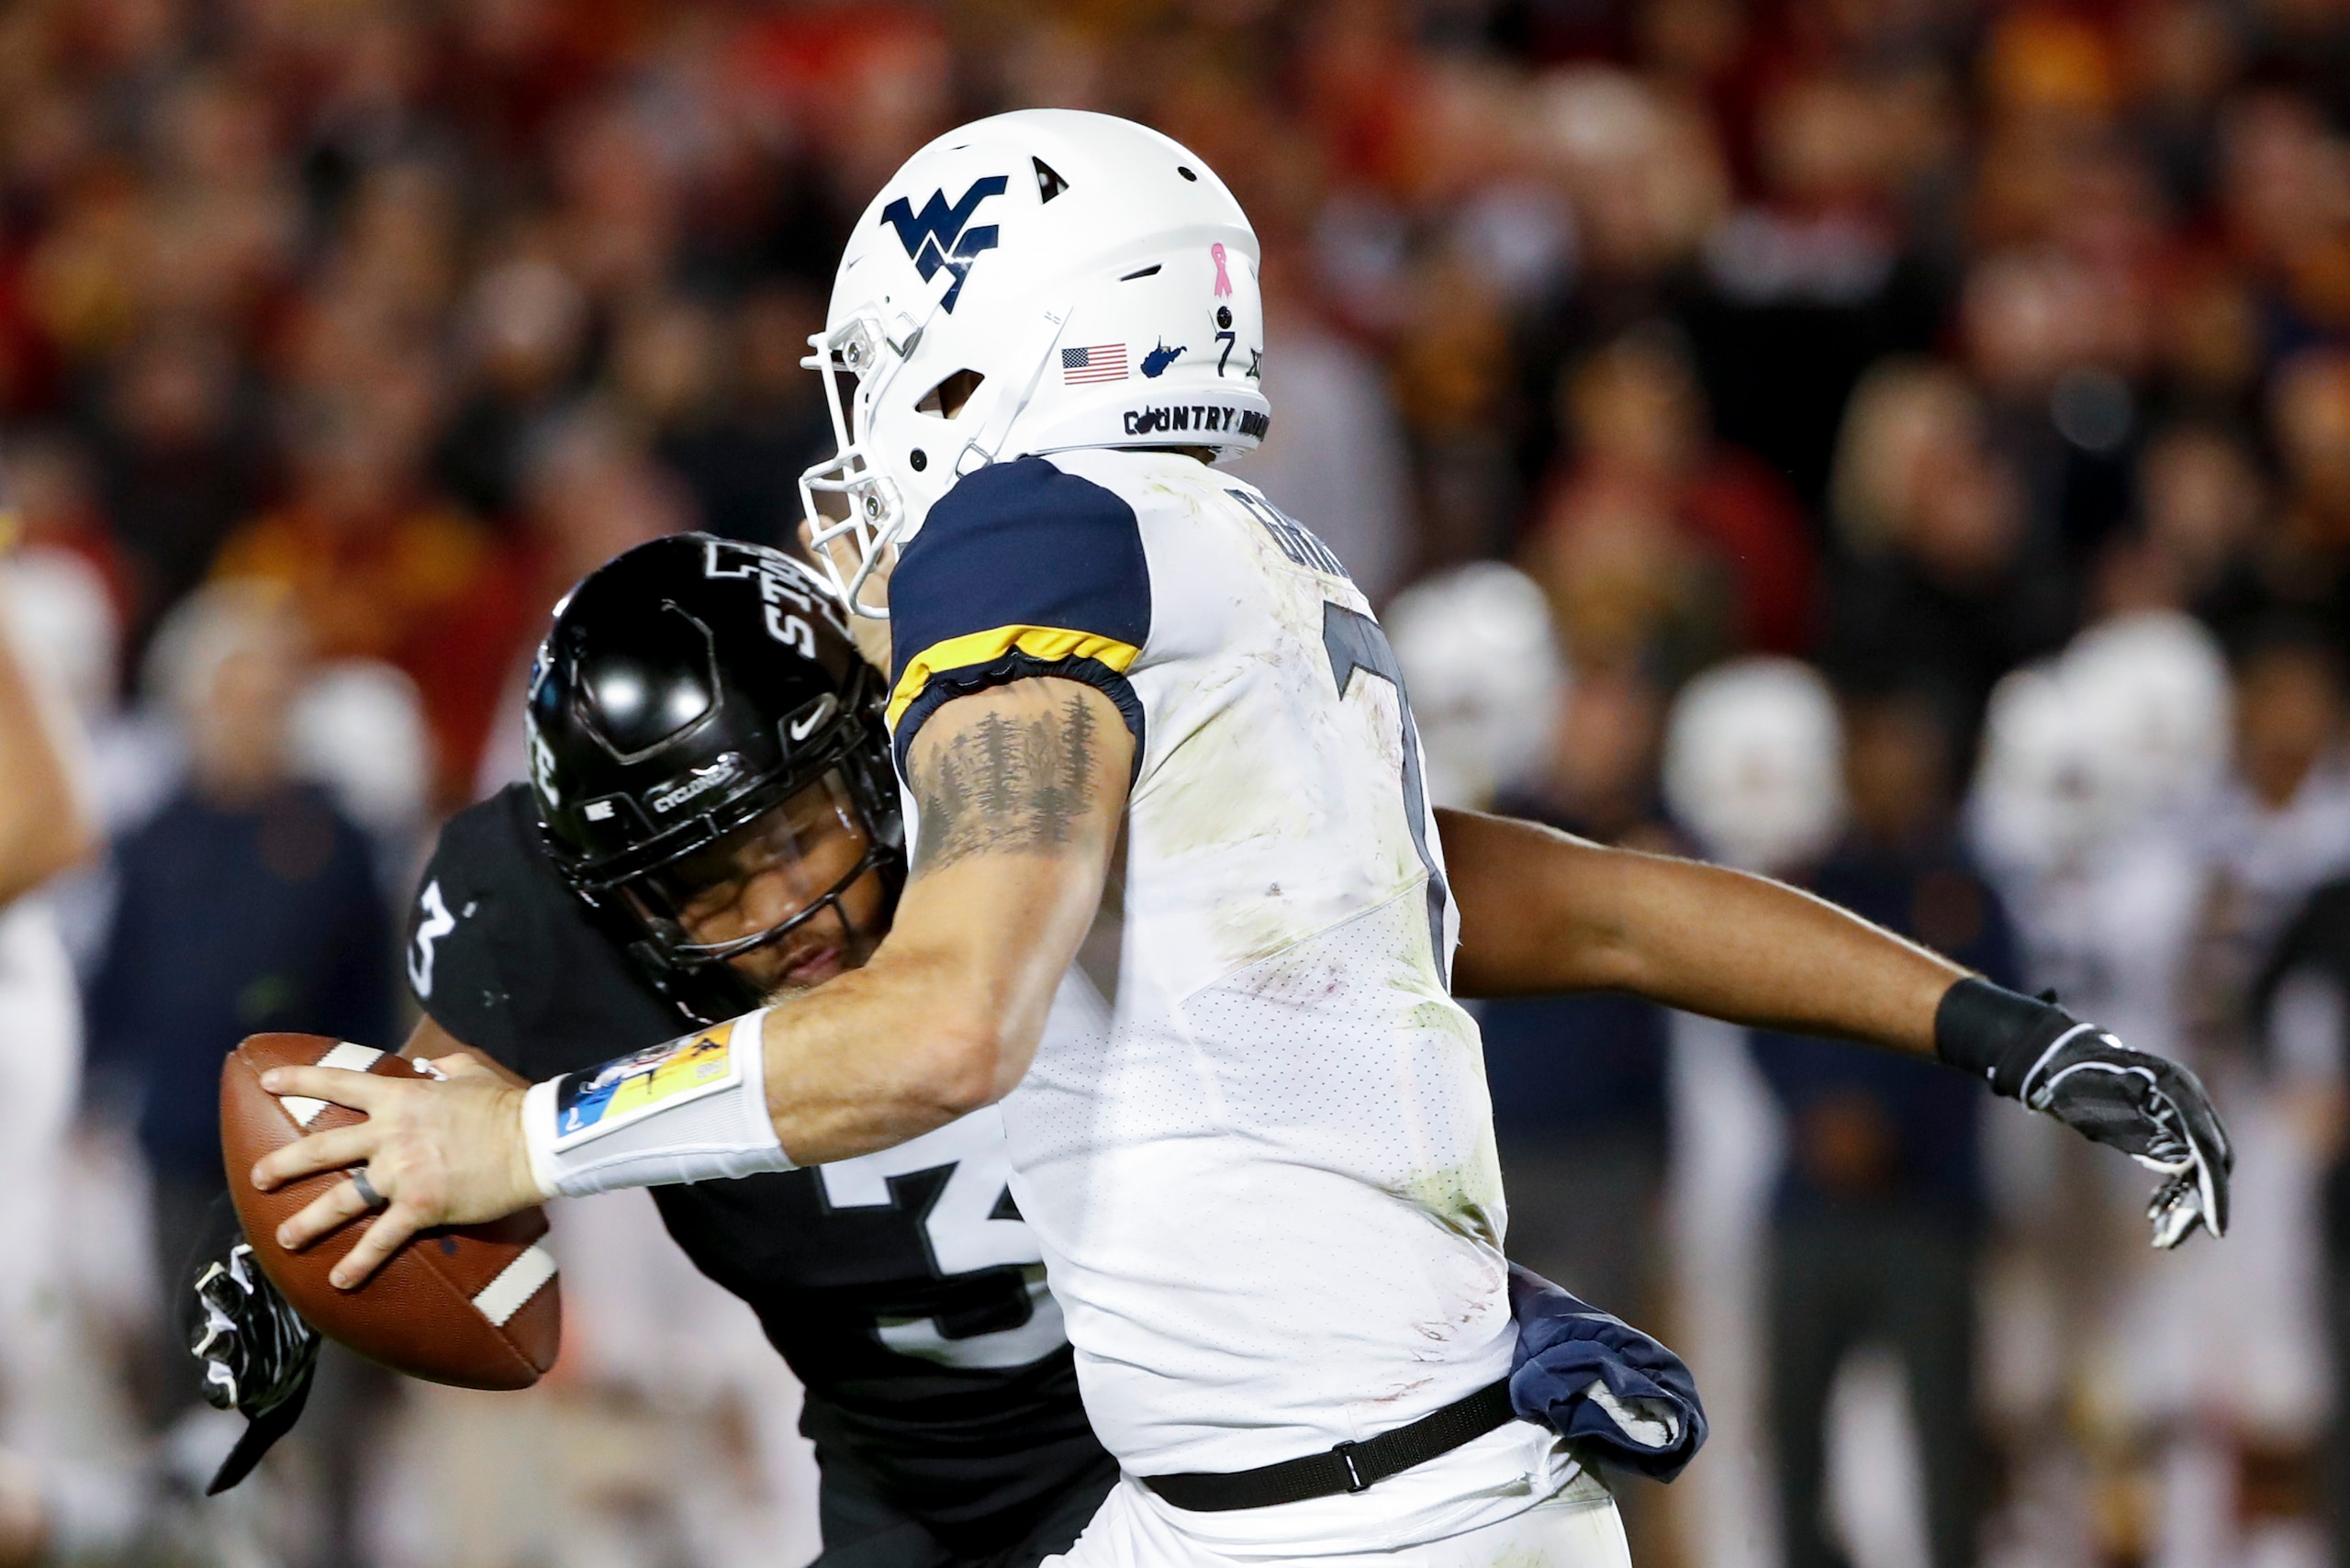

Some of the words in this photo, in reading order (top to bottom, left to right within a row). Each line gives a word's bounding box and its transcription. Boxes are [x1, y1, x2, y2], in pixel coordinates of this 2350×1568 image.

[1214, 330, 1236, 377] 7
[1124, 405, 1236, 435] CUNTRY
[1323, 599, 1448, 989] 7
[406, 878, 456, 1001] 3
[820, 1109, 1071, 1370] 3
